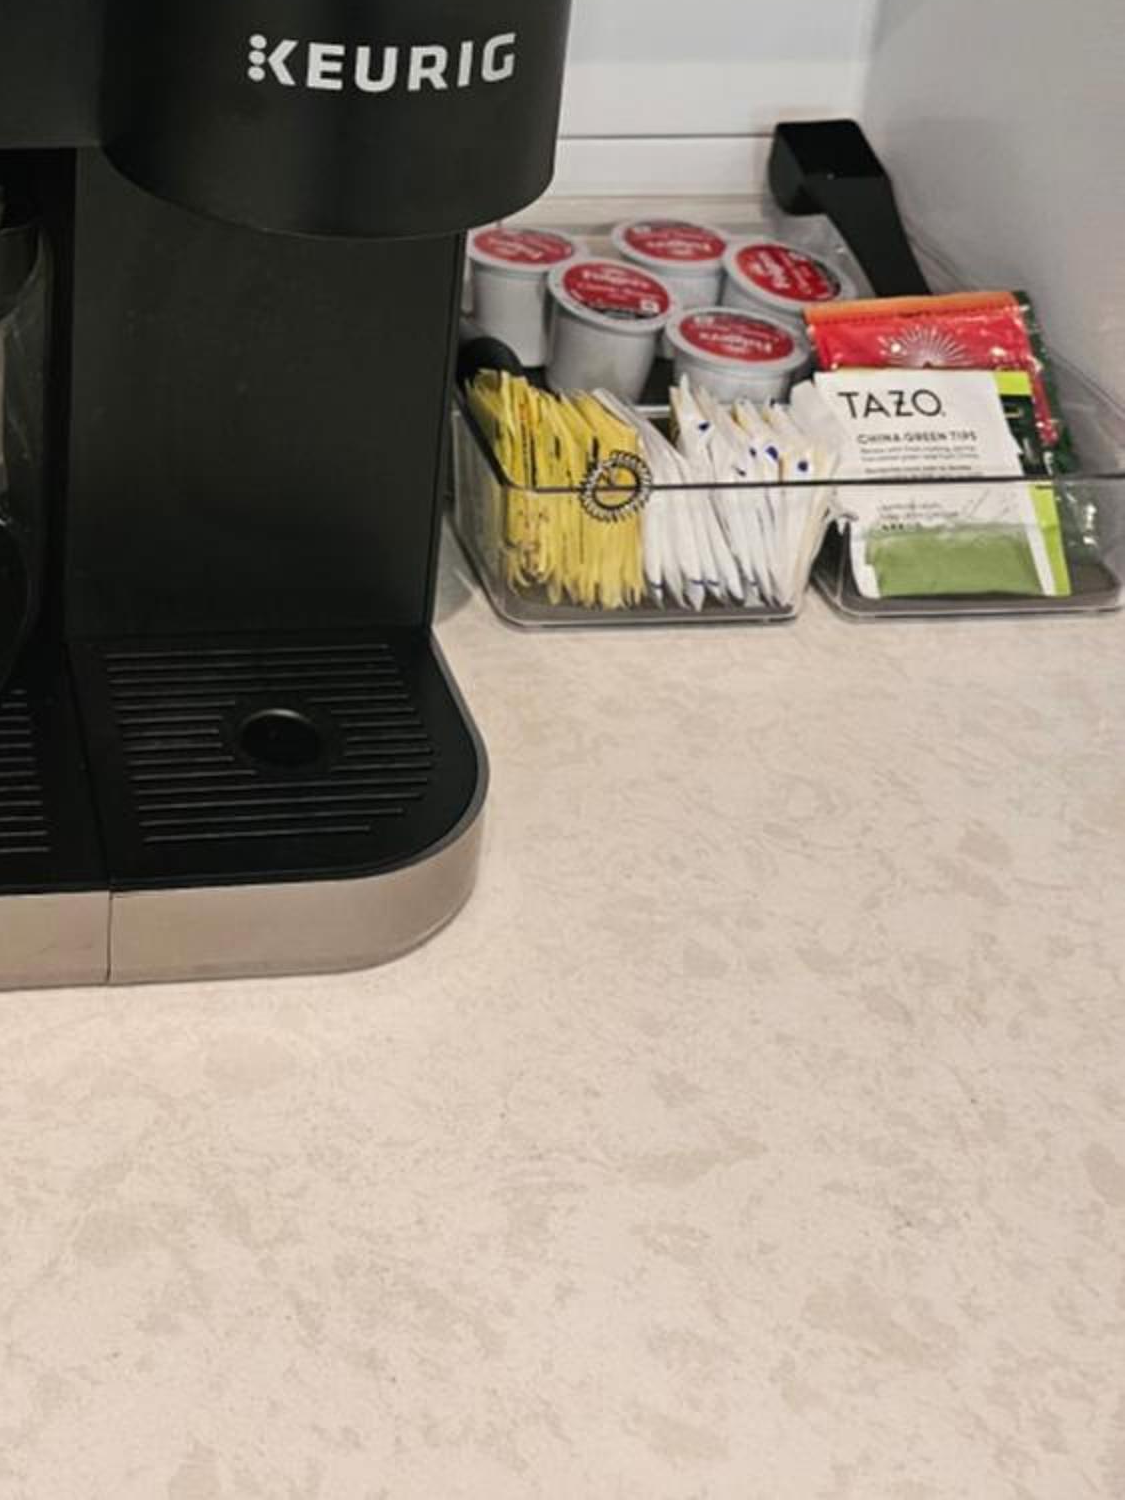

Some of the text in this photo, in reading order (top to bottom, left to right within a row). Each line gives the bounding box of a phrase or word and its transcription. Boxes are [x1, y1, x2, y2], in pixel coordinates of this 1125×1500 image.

[248, 33, 516, 93] KEURIG
[837, 389, 942, 419] TAZO
[857, 430, 977, 444] CHINA GREEN TIPS
